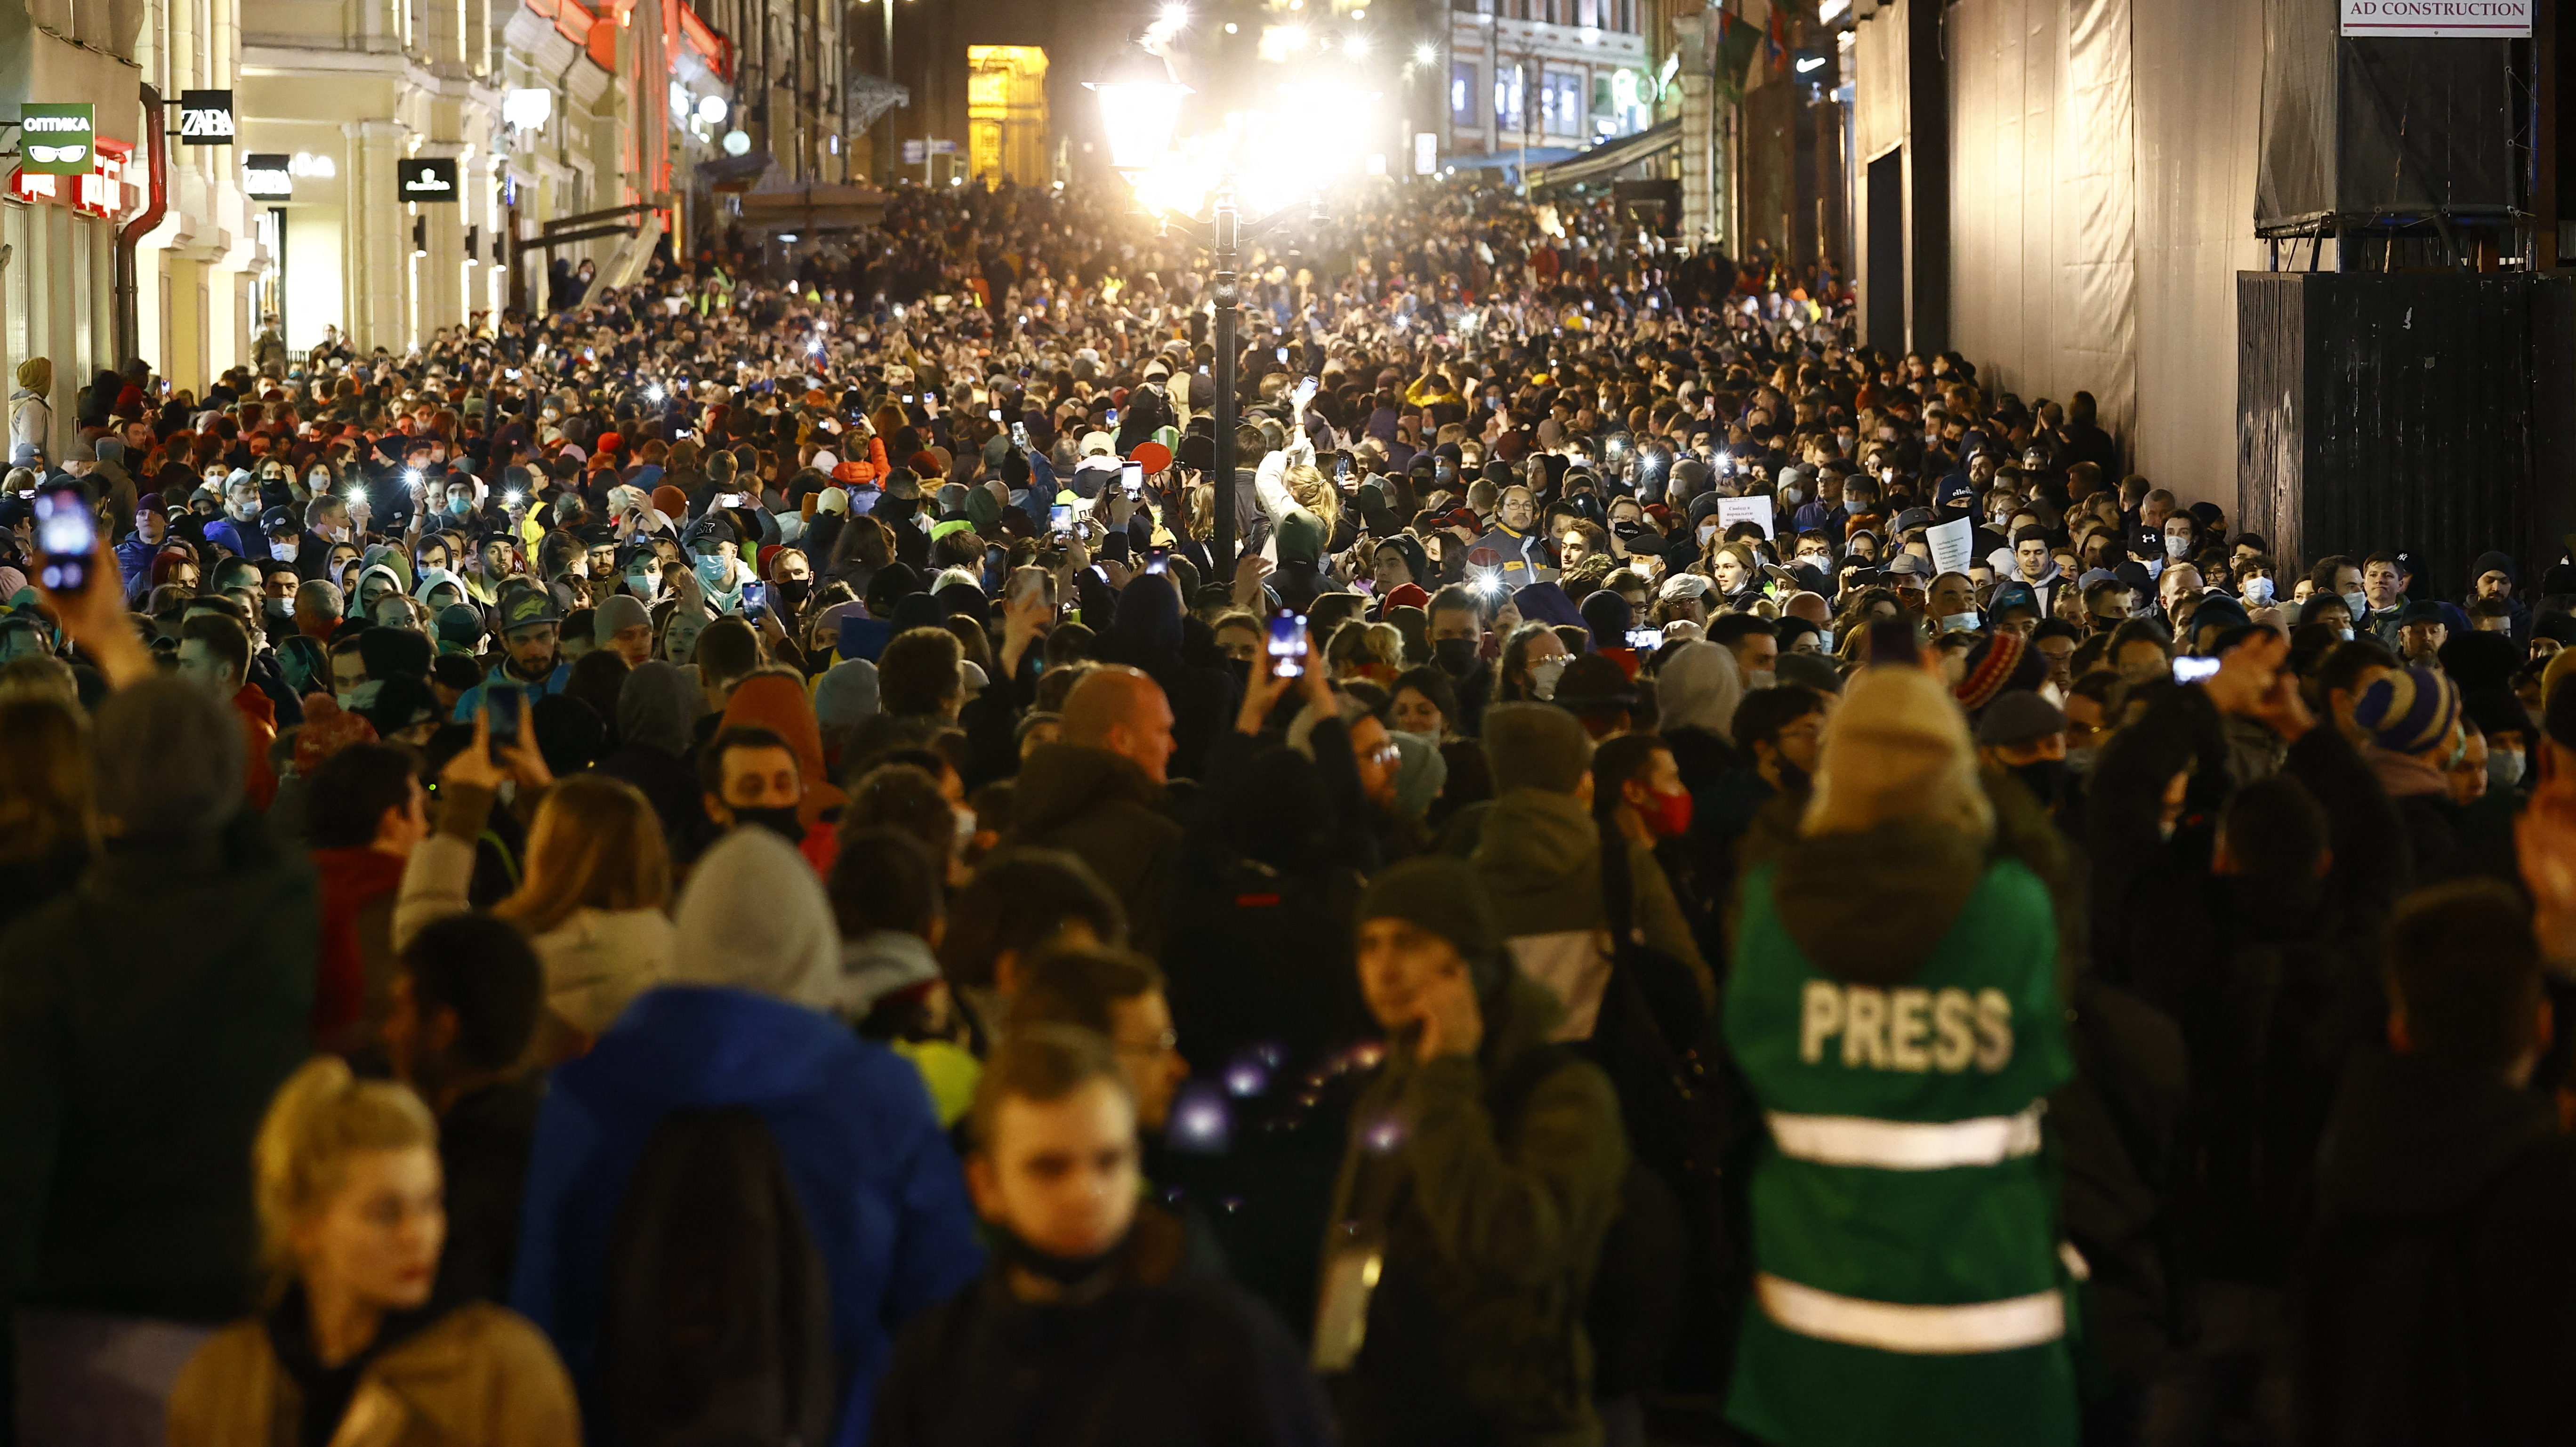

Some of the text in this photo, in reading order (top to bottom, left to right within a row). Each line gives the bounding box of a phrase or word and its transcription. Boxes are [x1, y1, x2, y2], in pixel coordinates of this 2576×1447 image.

[2351, 2, 2524, 16] AD CONSTRUCTION
[24, 117, 91, 131] ОПТИКА
[181, 109, 234, 136] ZARA
[1800, 979, 2014, 1073] PRESS
